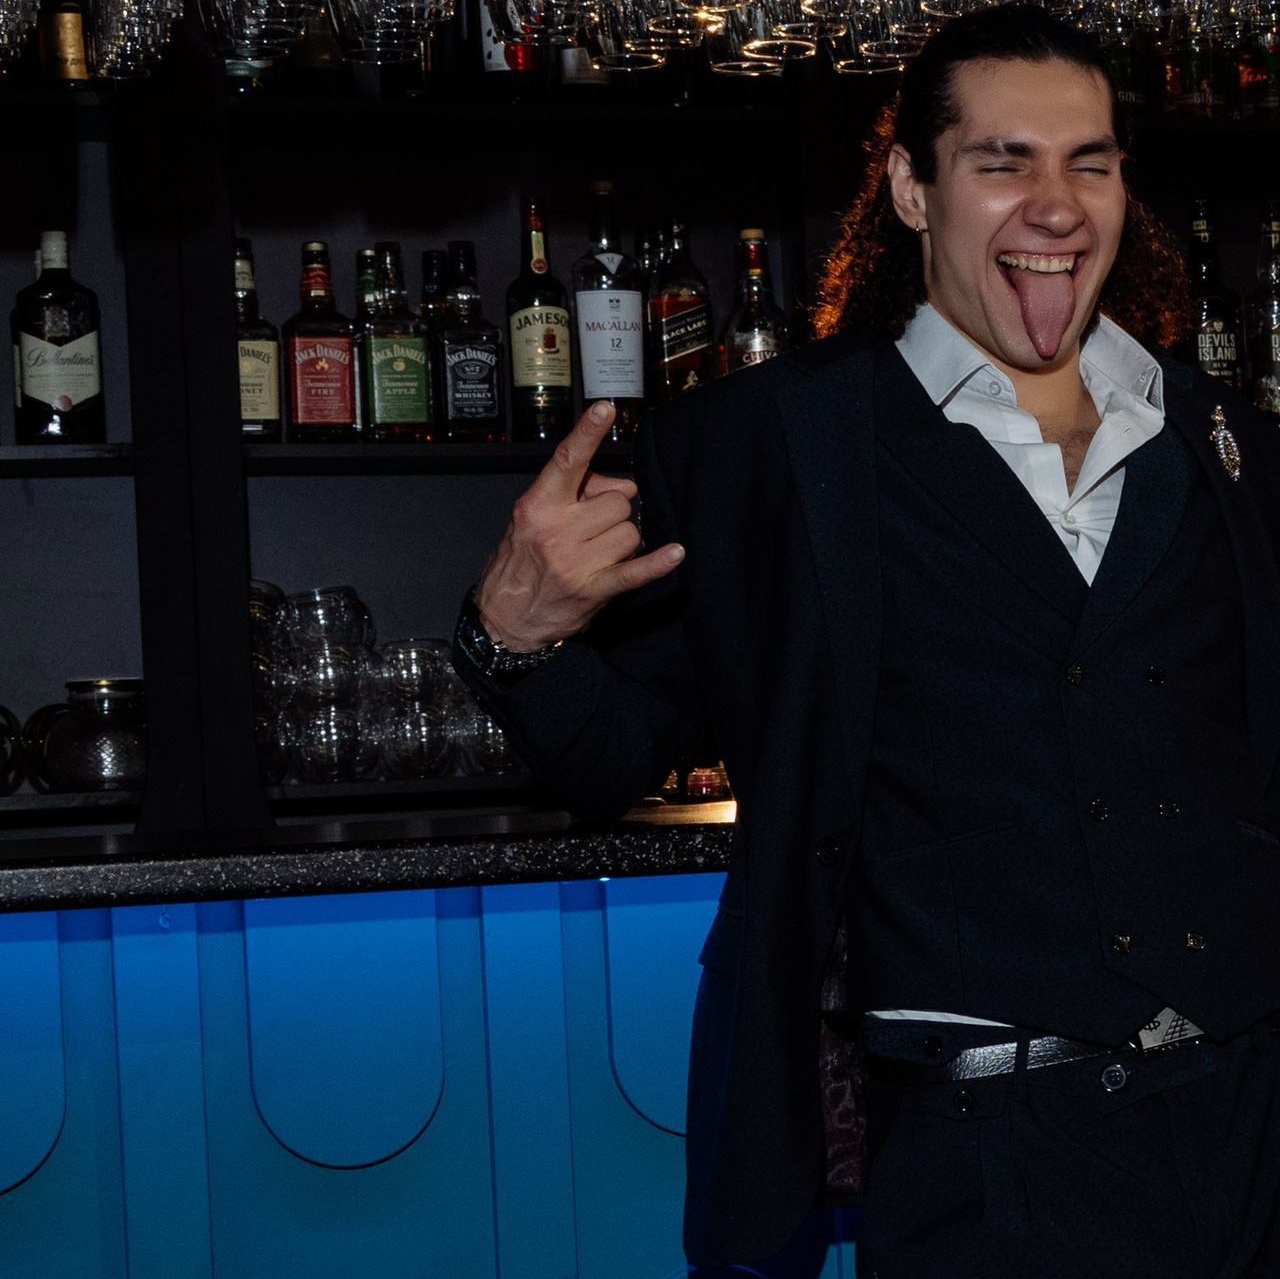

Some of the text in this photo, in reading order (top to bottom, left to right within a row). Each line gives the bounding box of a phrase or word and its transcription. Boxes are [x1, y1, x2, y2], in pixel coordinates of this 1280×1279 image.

[516, 312, 568, 331] JAMESO
[585, 322, 641, 331] MACALLAN
[686, 319, 707, 334] LABE
[611, 338, 622, 348] 12
[1198, 334, 1235, 348] DEVILS
[240, 346, 272, 365] DANIEL'S
[295, 344, 350, 365] JACK DANIEL'S
[372, 344, 425, 364] JACK DANIEL'S
[447, 348, 497, 366] JACK DANIEL'S
[742, 351, 778, 363] CHIVA
[1198, 347, 1237, 361] ISLAND
